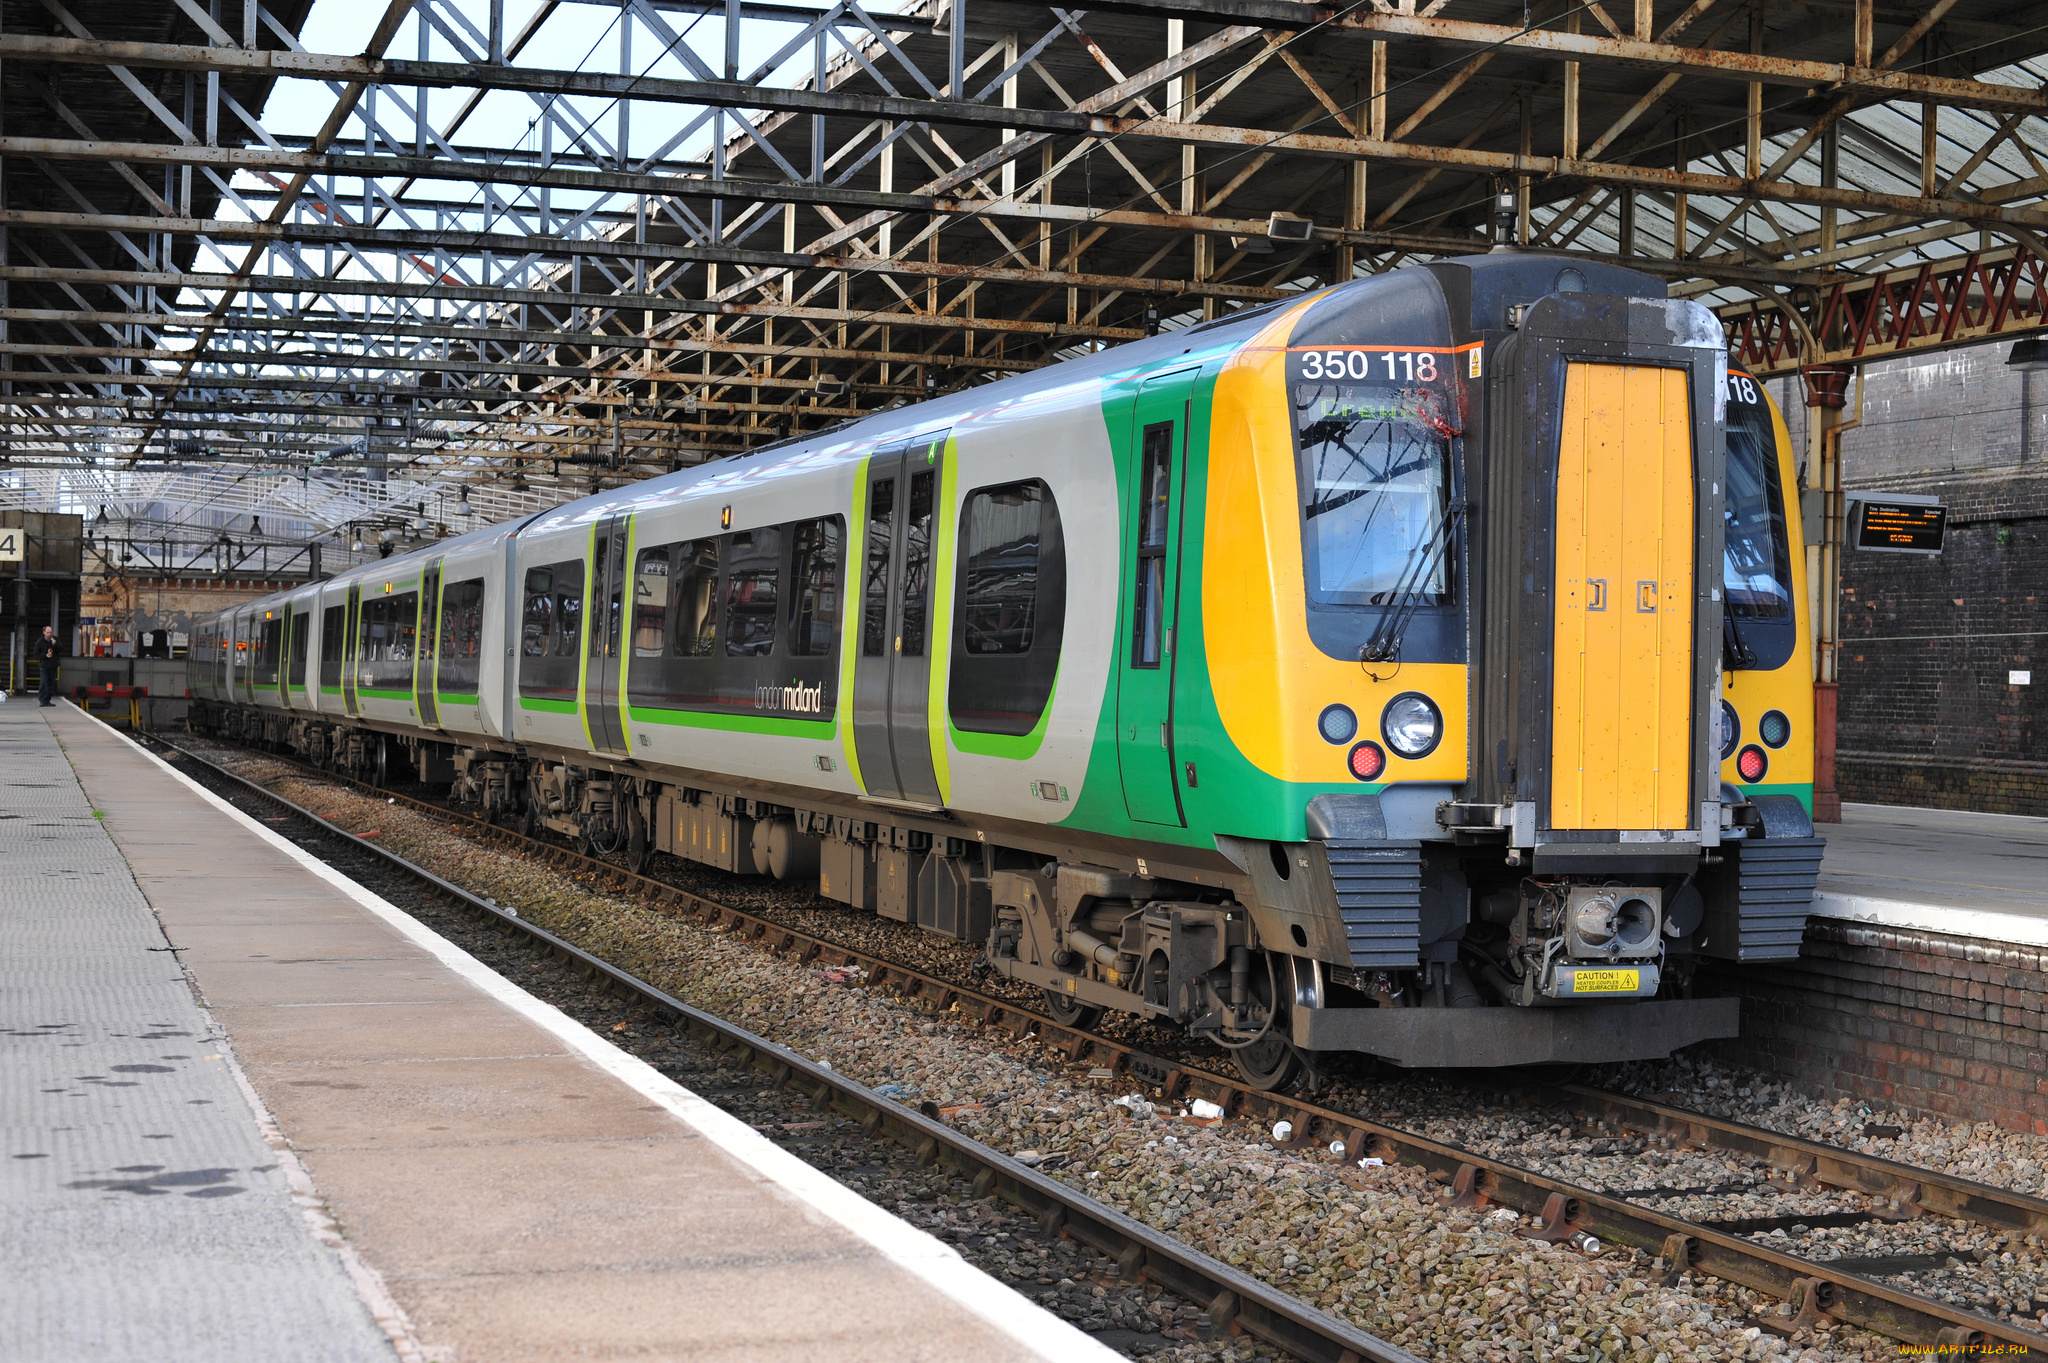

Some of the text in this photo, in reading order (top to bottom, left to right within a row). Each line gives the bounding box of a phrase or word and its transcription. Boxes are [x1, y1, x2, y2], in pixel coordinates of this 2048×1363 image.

[1302, 350, 1438, 382] 350 118
[0, 535, 16, 555] 4
[1576, 972, 1614, 980] CAUTION
